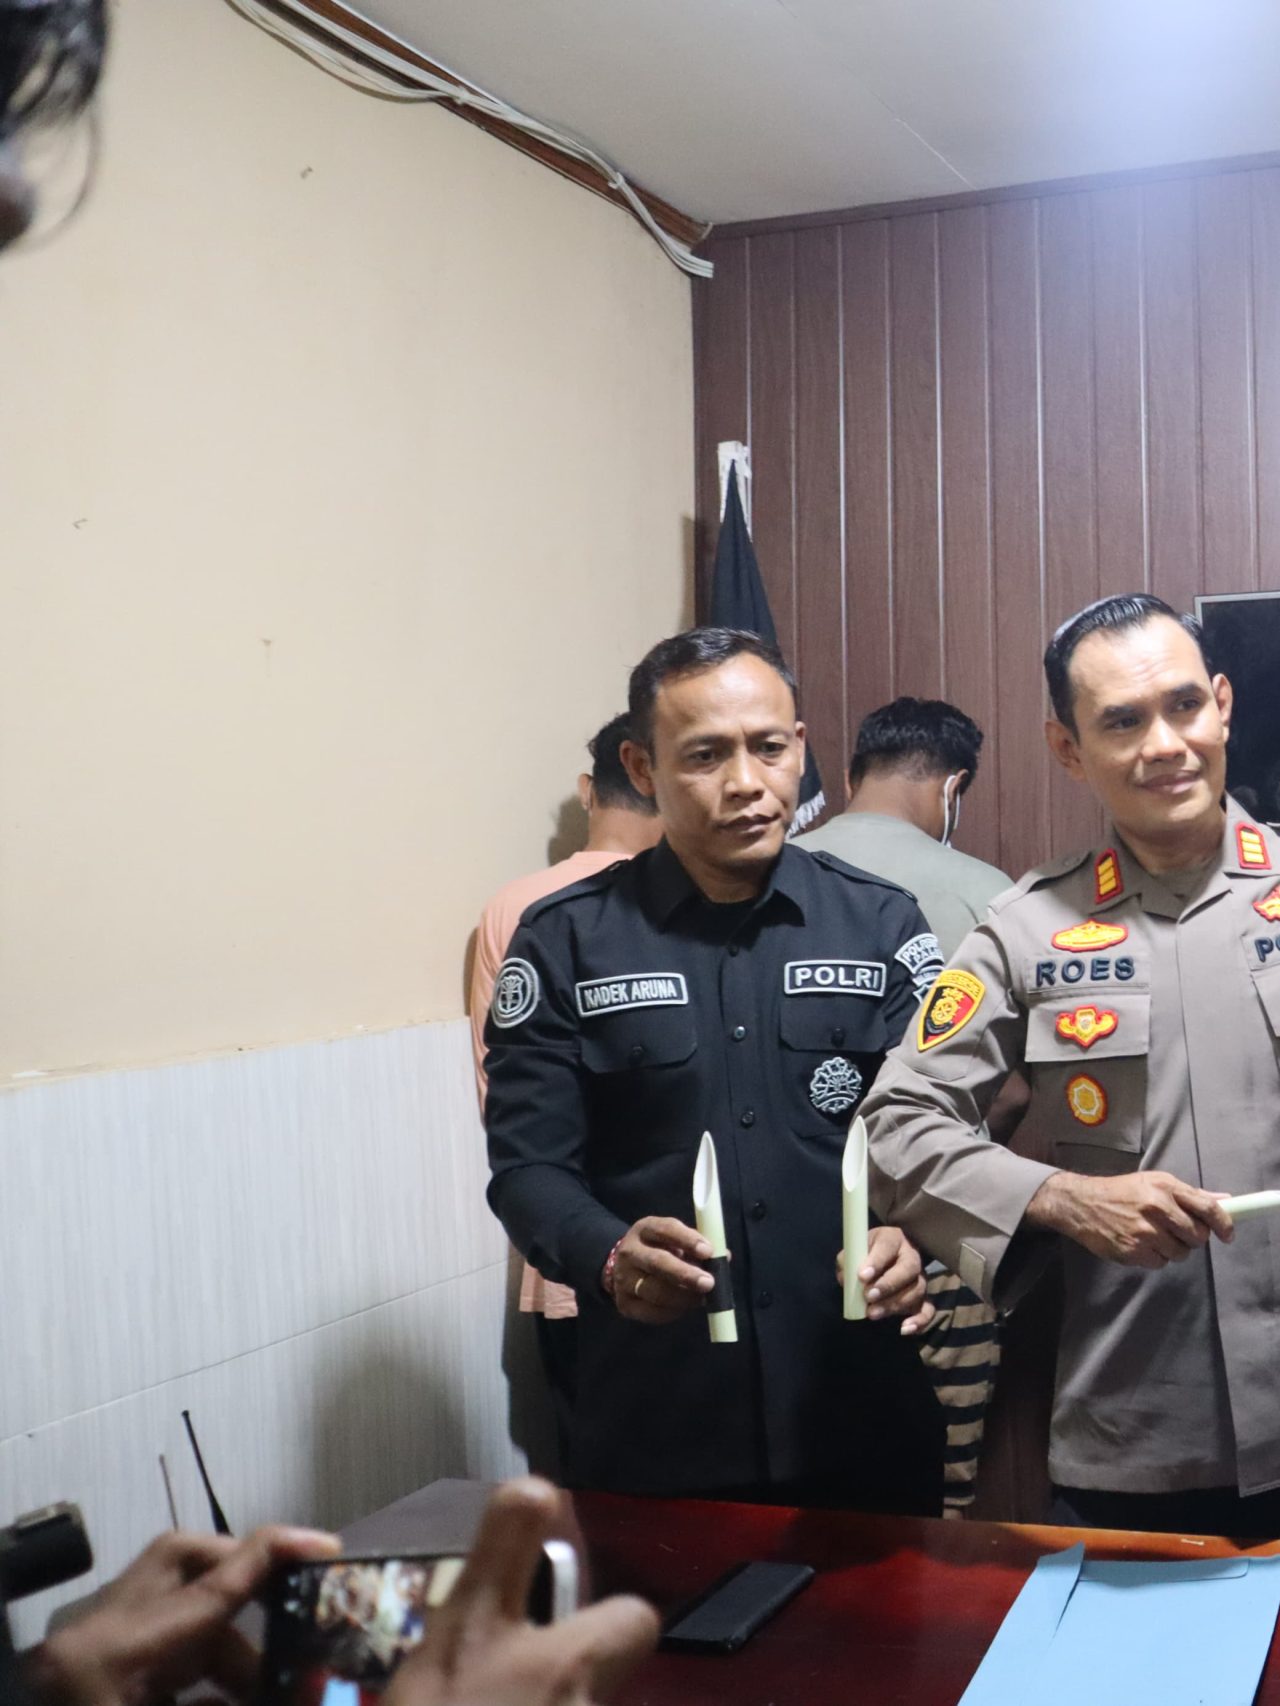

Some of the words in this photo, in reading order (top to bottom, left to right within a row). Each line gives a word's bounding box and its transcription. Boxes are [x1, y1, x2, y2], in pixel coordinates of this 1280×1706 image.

[794, 966, 880, 989] POLRI
[1035, 956, 1135, 988] ROES
[583, 982, 629, 1010] KADEK
[631, 979, 677, 1001] ARUNA
